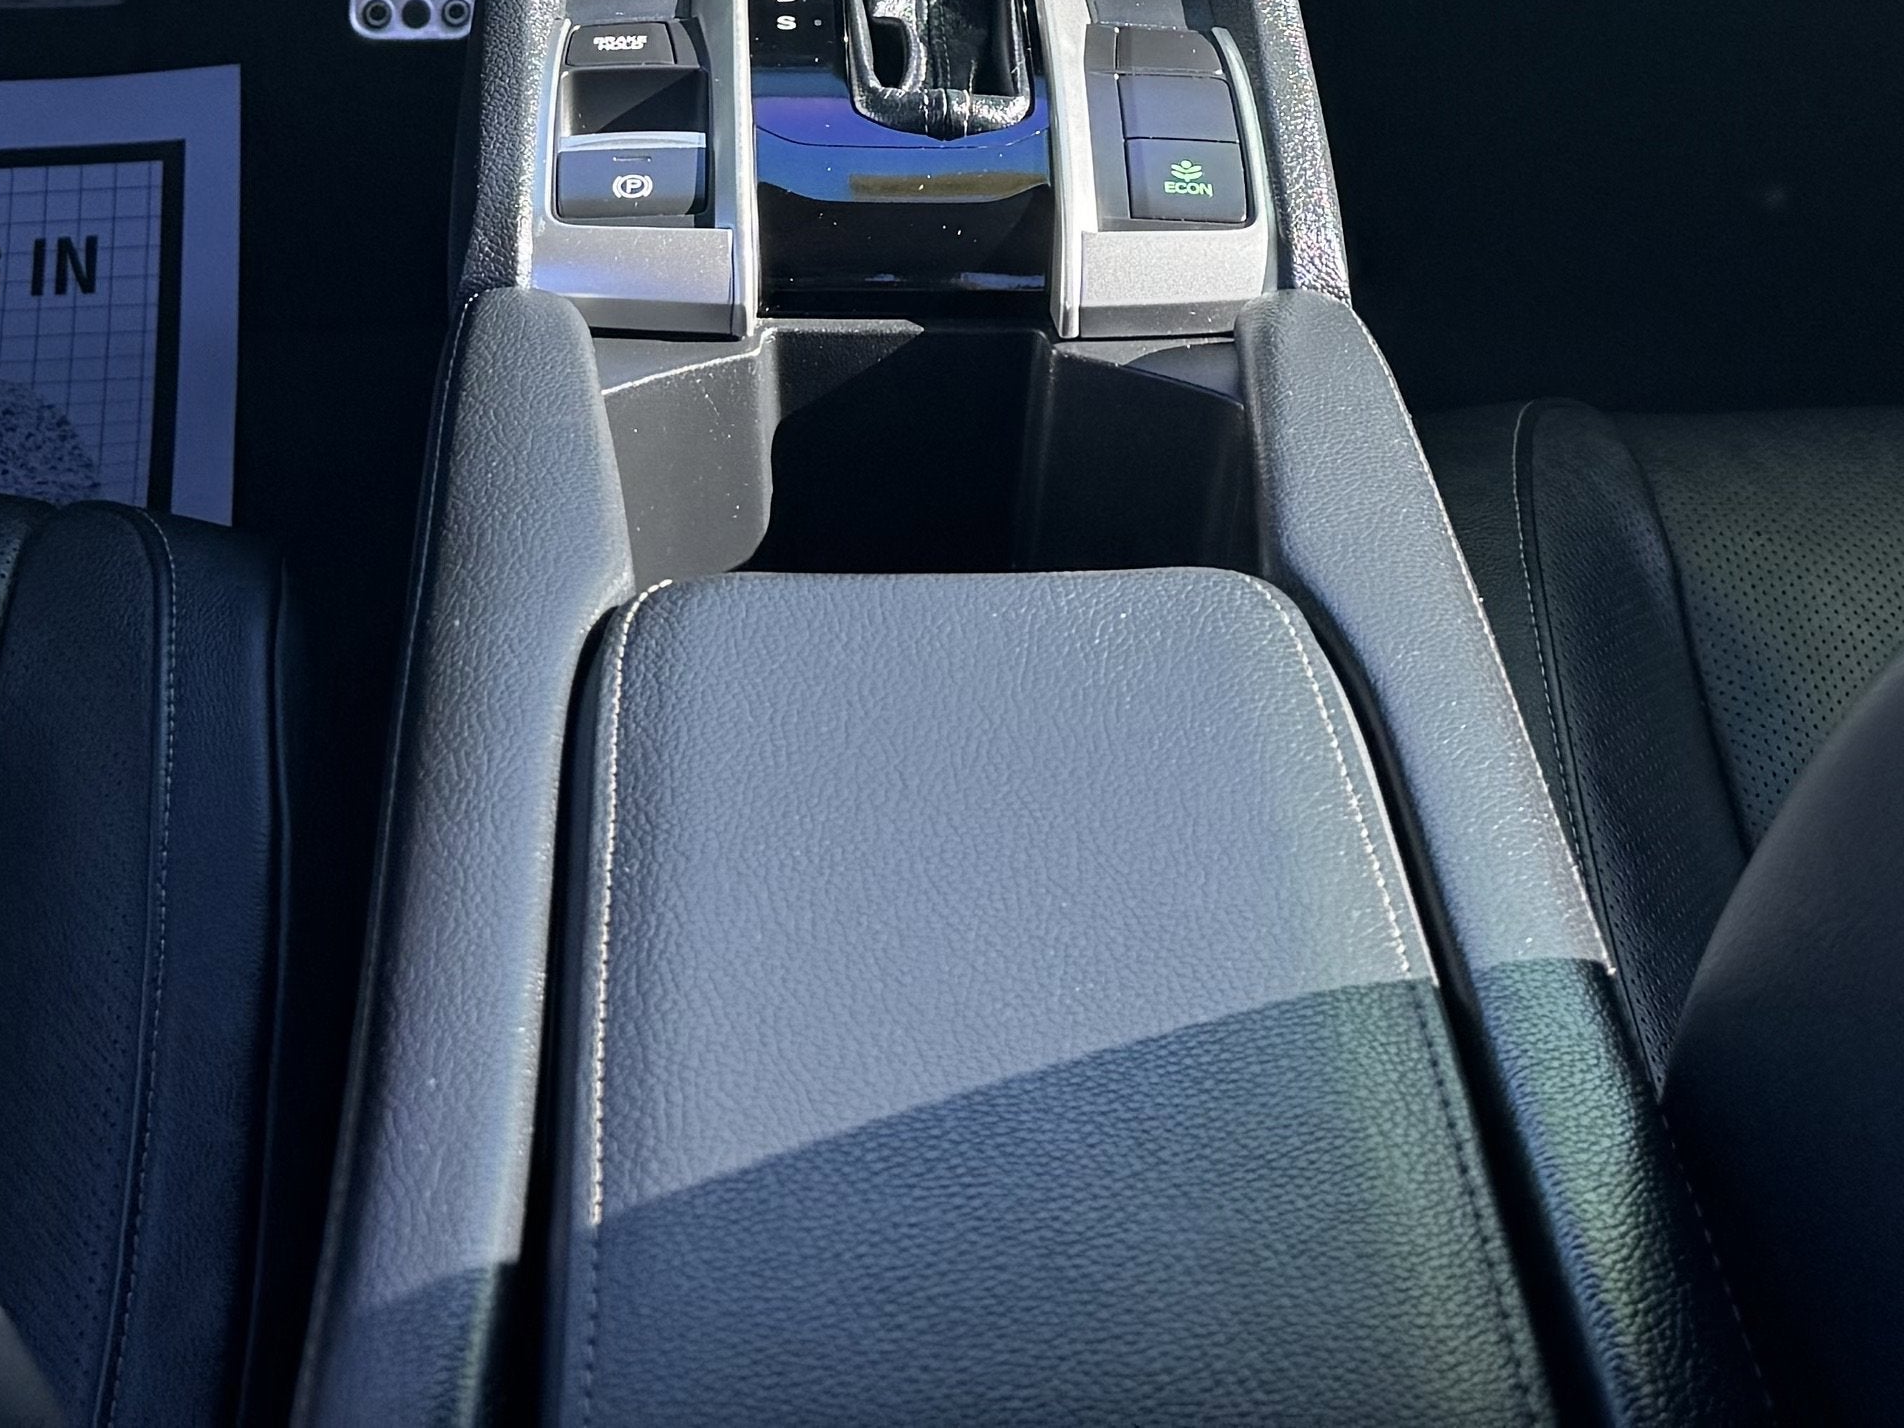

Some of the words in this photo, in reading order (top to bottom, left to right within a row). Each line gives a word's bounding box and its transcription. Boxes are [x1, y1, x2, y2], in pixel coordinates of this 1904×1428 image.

[776, 15, 797, 30] S
[593, 35, 648, 45] BRAKE
[598, 43, 644, 51] HOLD
[1164, 181, 1213, 197] ECON
[30, 235, 98, 297] IN
